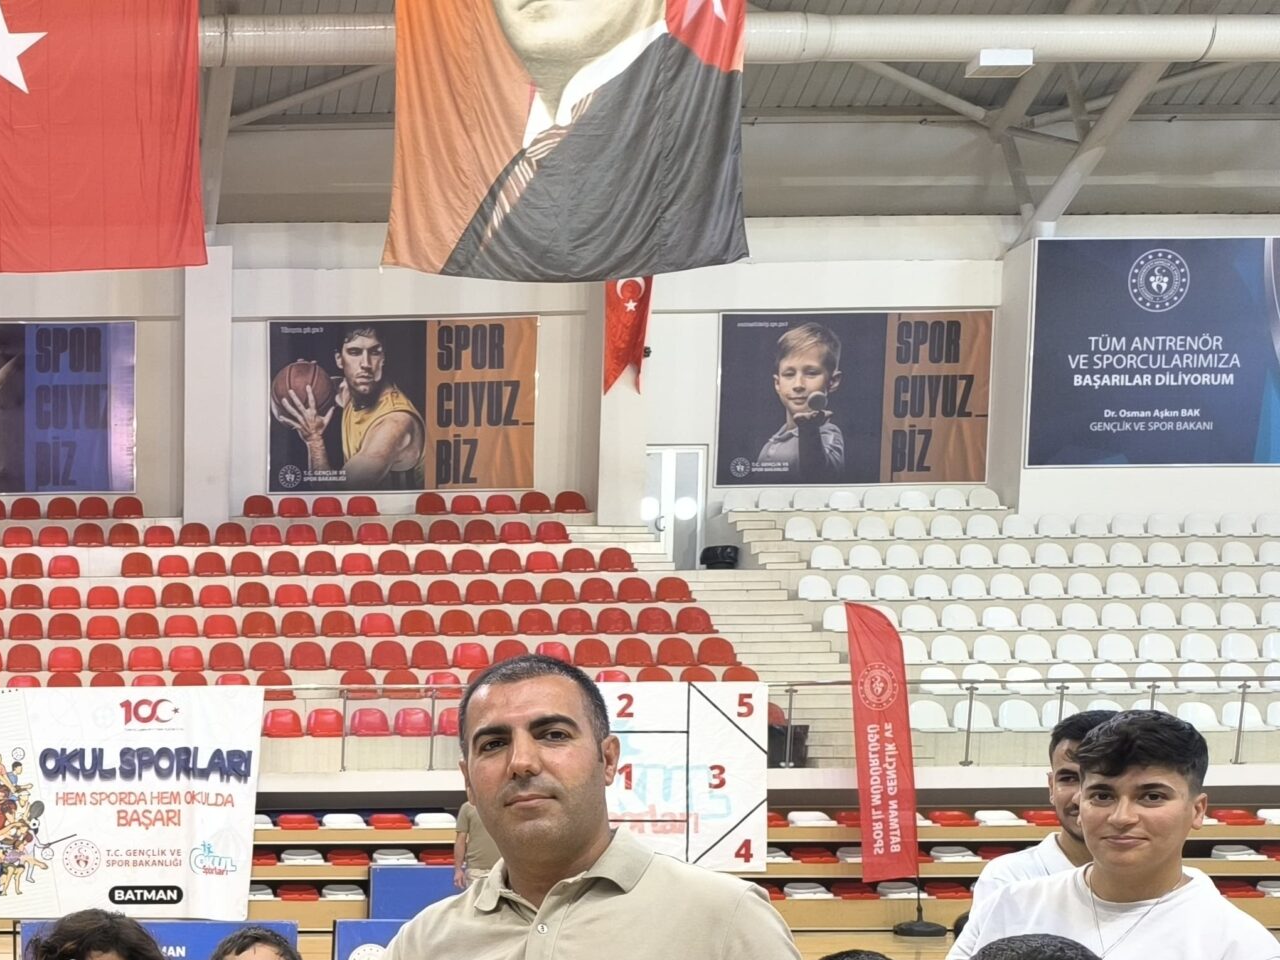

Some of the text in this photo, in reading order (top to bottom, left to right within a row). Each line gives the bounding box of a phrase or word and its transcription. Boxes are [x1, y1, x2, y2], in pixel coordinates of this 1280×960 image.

[35, 327, 101, 373] SPOR
[436, 323, 505, 371] SPOR
[896, 320, 961, 364] SPOR
[1088, 333, 1223, 351] TÜM ANTRENÖR
[1068, 353, 1241, 369] VE SPORCULARIMIZA
[1073, 371, 1235, 389] BAŞARILAR DİLİYORUM
[436, 380, 521, 428] CUYUZ
[893, 374, 974, 418] CUYUZ
[1104, 409, 1200, 419] Dr. Osman Aşkın BAK
[1090, 421, 1213, 433] GENÇLİK VE SPOR BAKANI
[435, 433, 478, 485] BİZ
[891, 424, 933, 482] BİZ
[616, 693, 634, 718] 2
[736, 693, 754, 718] 5
[39, 747, 253, 784] OKUL SPORLARI
[618, 763, 632, 790] 1
[708, 764, 726, 789] 3
[55, 791, 235, 808] HEM SPORDA HEM OKULDA
[116, 809, 181, 830] BAŞARI
[106, 848, 182, 858] T.C. GENÇLİK VE
[106, 858, 182, 867] SPOR BAKANLIĞI
[734, 838, 753, 863] 4
[114, 889, 178, 901] BATMAN
